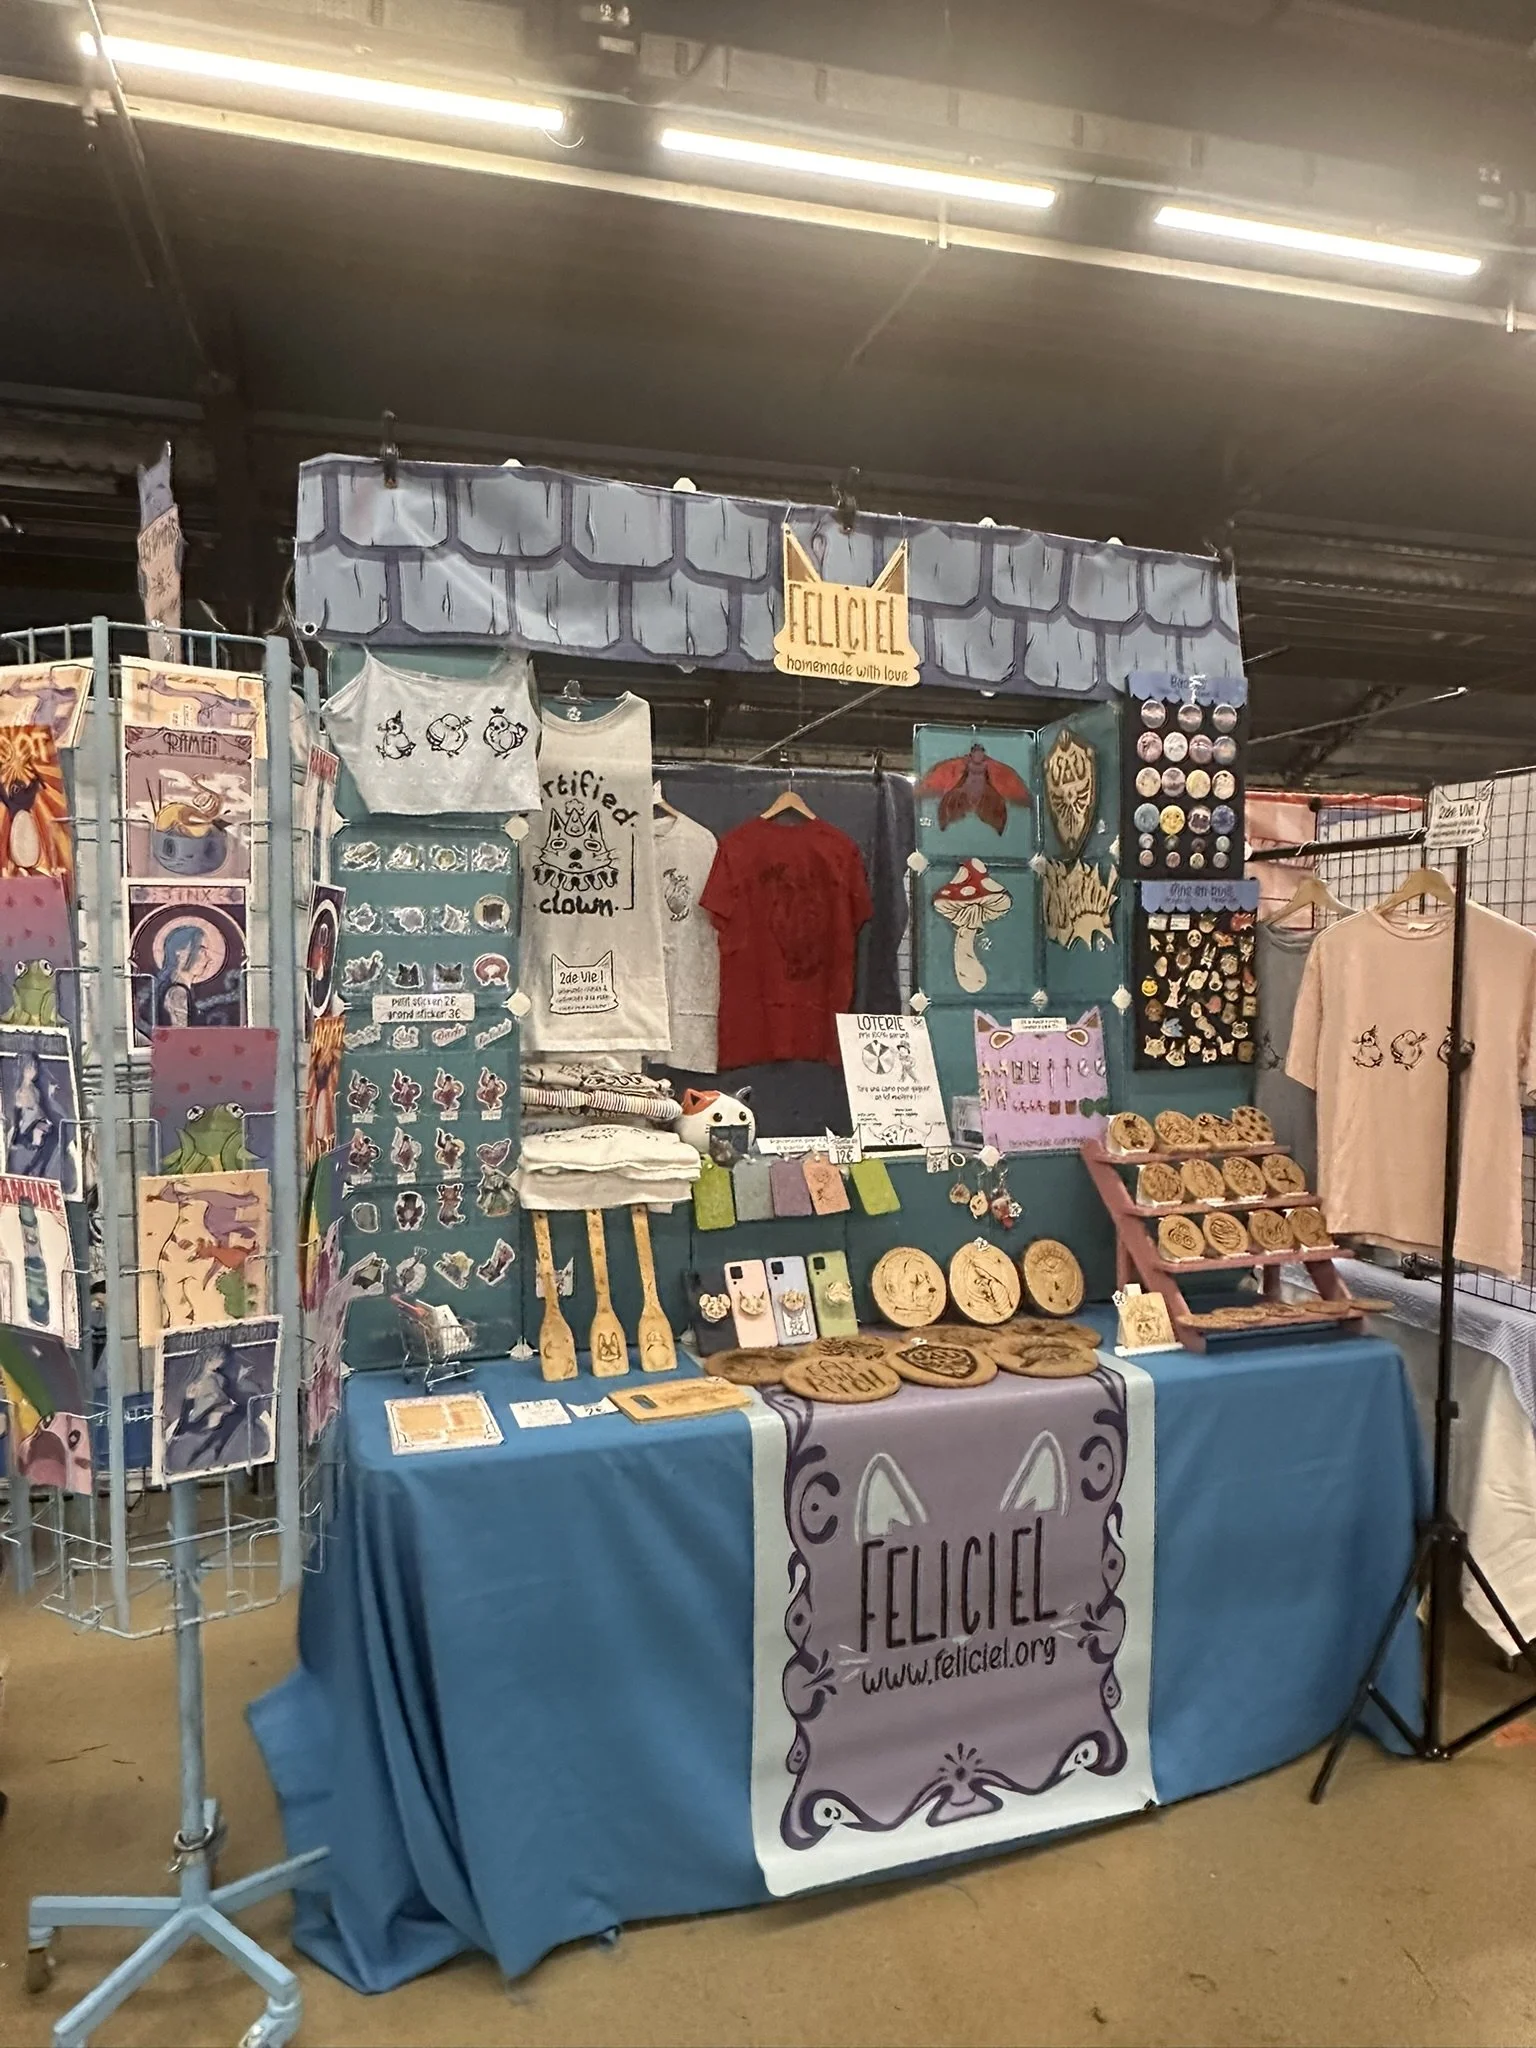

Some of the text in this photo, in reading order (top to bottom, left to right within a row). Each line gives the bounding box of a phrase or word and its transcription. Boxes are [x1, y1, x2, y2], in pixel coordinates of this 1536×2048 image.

[788, 583, 905, 656] FELICIEL
[786, 654, 910, 682] homemade with love
[542, 769, 639, 826] rtified
[539, 889, 613, 917] clown
[560, 971, 578, 985] 2de
[448, 1008, 461, 1019] 3€
[857, 1015, 906, 1031] LOTERIE
[836, 1149, 854, 1164] 12€
[860, 1516, 1058, 1653] FELICIEL
[861, 1635, 1057, 1695] www.feliciel.org
